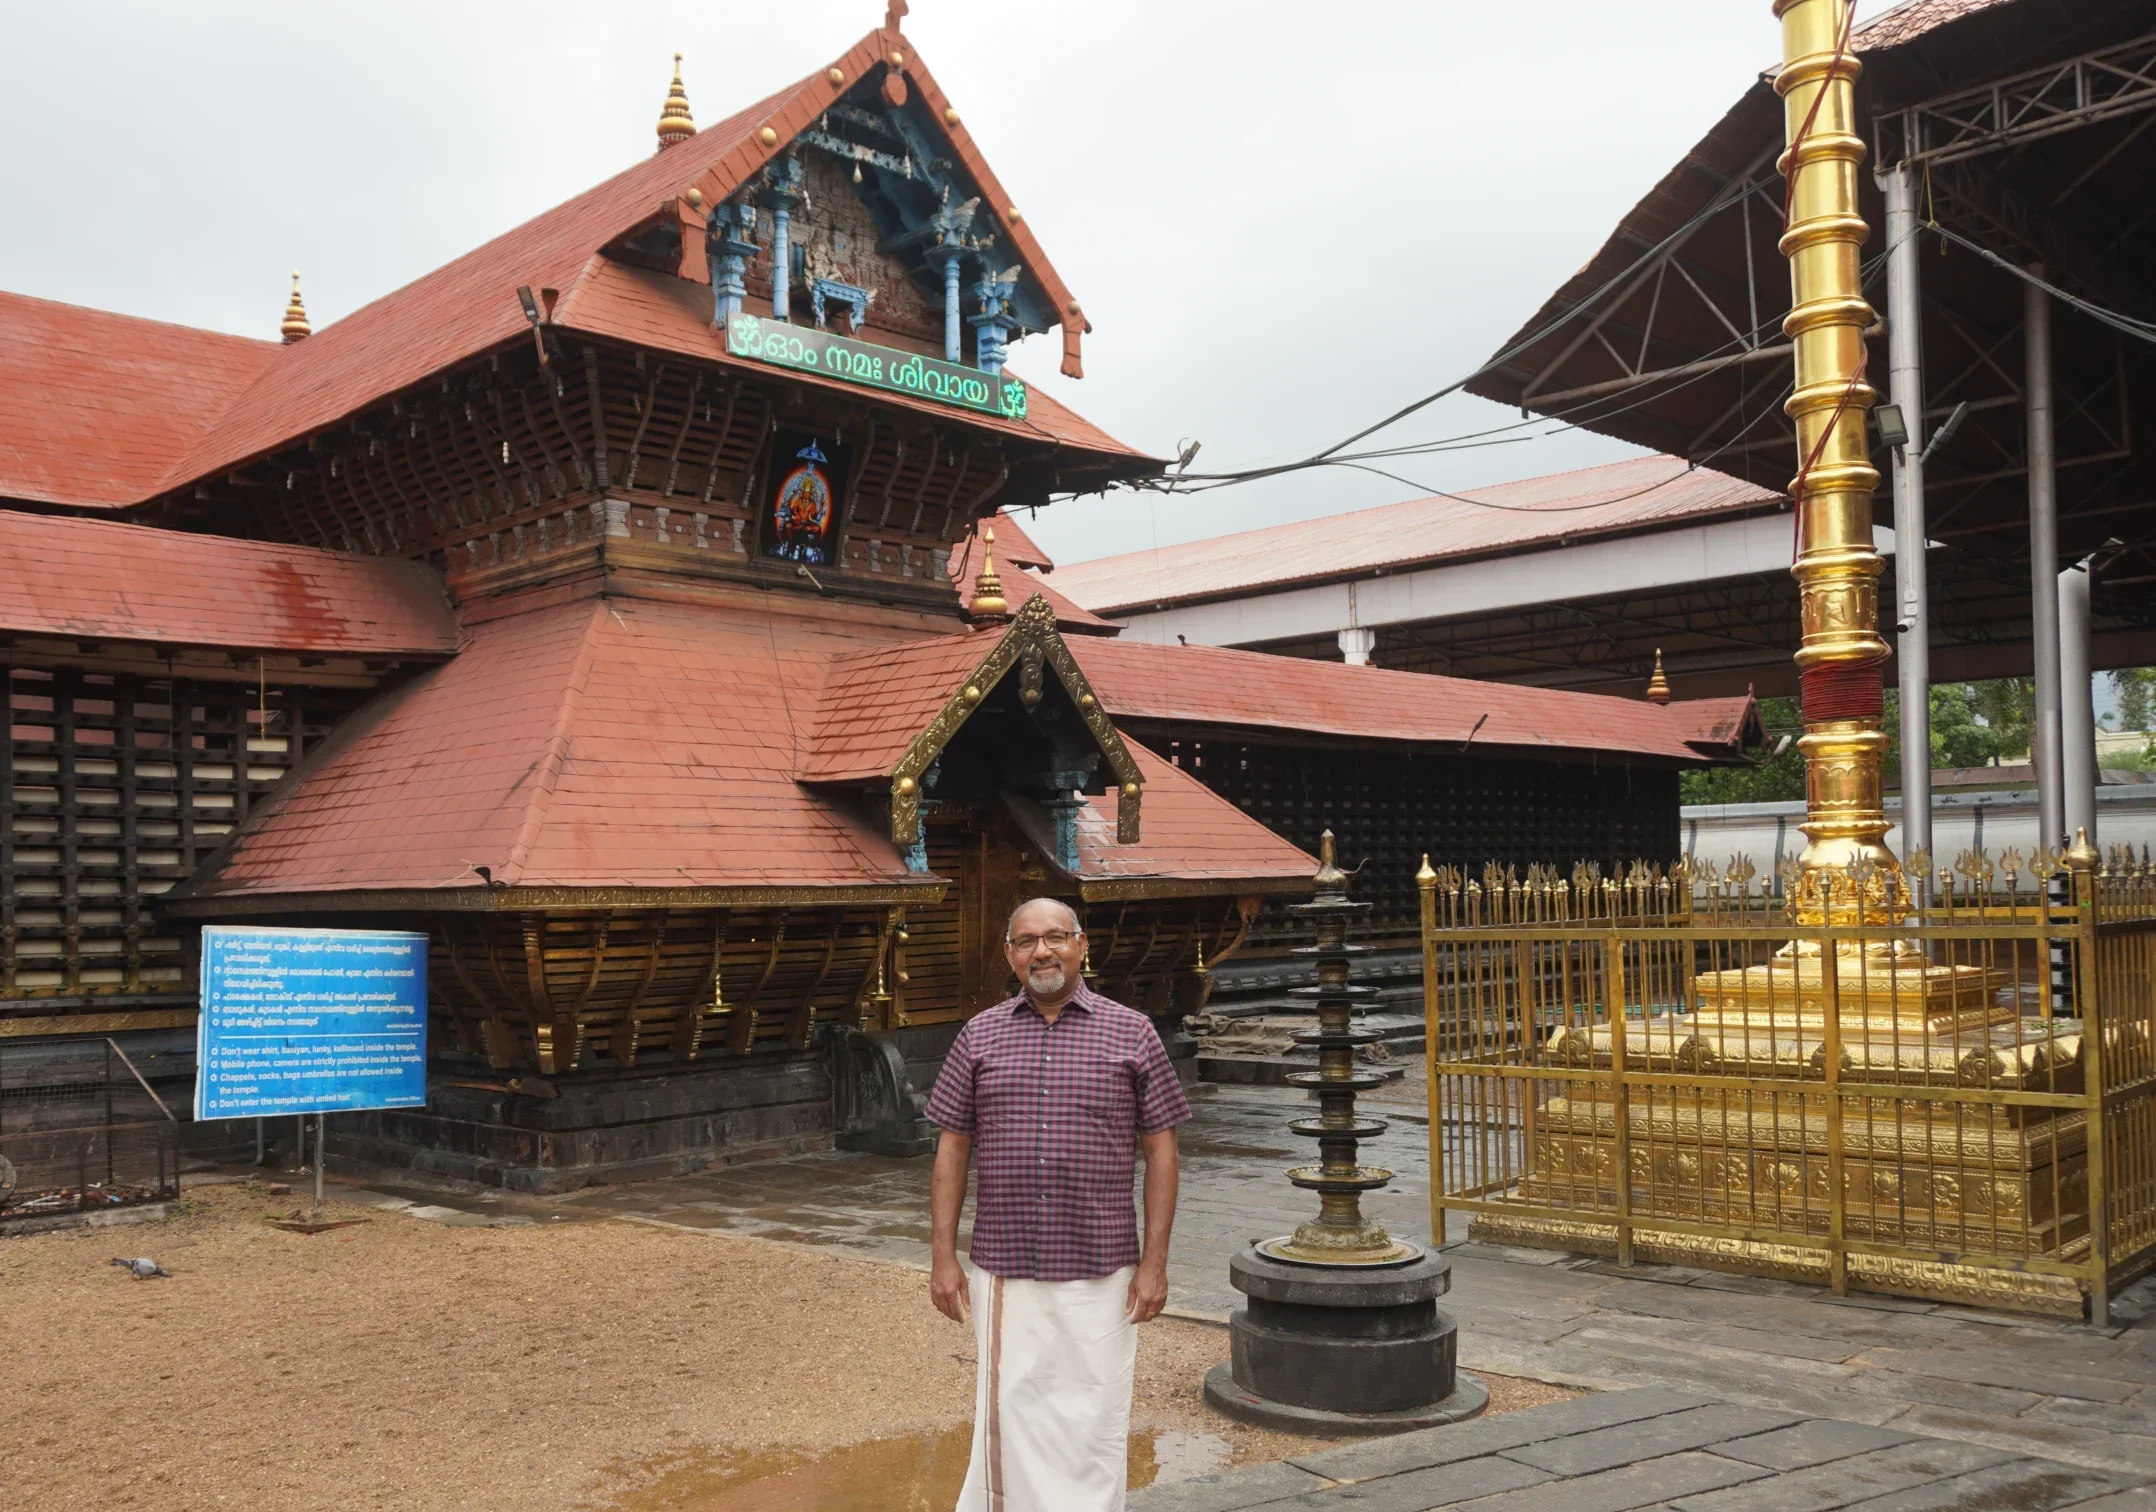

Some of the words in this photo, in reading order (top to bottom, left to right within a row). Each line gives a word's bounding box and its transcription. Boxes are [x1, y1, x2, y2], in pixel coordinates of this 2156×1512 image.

[764, 332, 818, 366] ഓം
[826, 345, 883, 380] നമഃ
[889, 357, 989, 404] ശിവായ
[221, 1047, 241, 1055] Don't
[261, 1046, 280, 1055] shirt,
[281, 1046, 311, 1055] baniyan,
[365, 1043, 384, 1052] inside
[385, 1043, 395, 1051] the
[396, 1042, 417, 1052] temple.
[221, 1060, 245, 1068] Mobile
[246, 1059, 271, 1069] phone,
[273, 1059, 299, 1067] camera
[313, 1057, 336, 1066] strictly
[337, 1055, 369, 1066] prohibited
[370, 1055, 389, 1063] inside
[400, 1054, 422, 1063] temple.
[258, 1072, 281, 1080] socks,
[283, 1071, 301, 1080] bags
[302, 1069, 335, 1078] umbrellas
[359, 1067, 384, 1076] allowed
[384, 1067, 403, 1075] inside
[219, 1087, 231, 1095] the
[233, 1086, 260, 1095] temple.
[219, 1099, 239, 1107] Don't
[240, 1099, 259, 1107] enter
[260, 1097, 273, 1105] the
[273, 1096, 298, 1106] temple
[299, 1095, 314, 1104] with
[315, 1094, 337, 1102] untied
[337, 1093, 351, 1101] hair.
